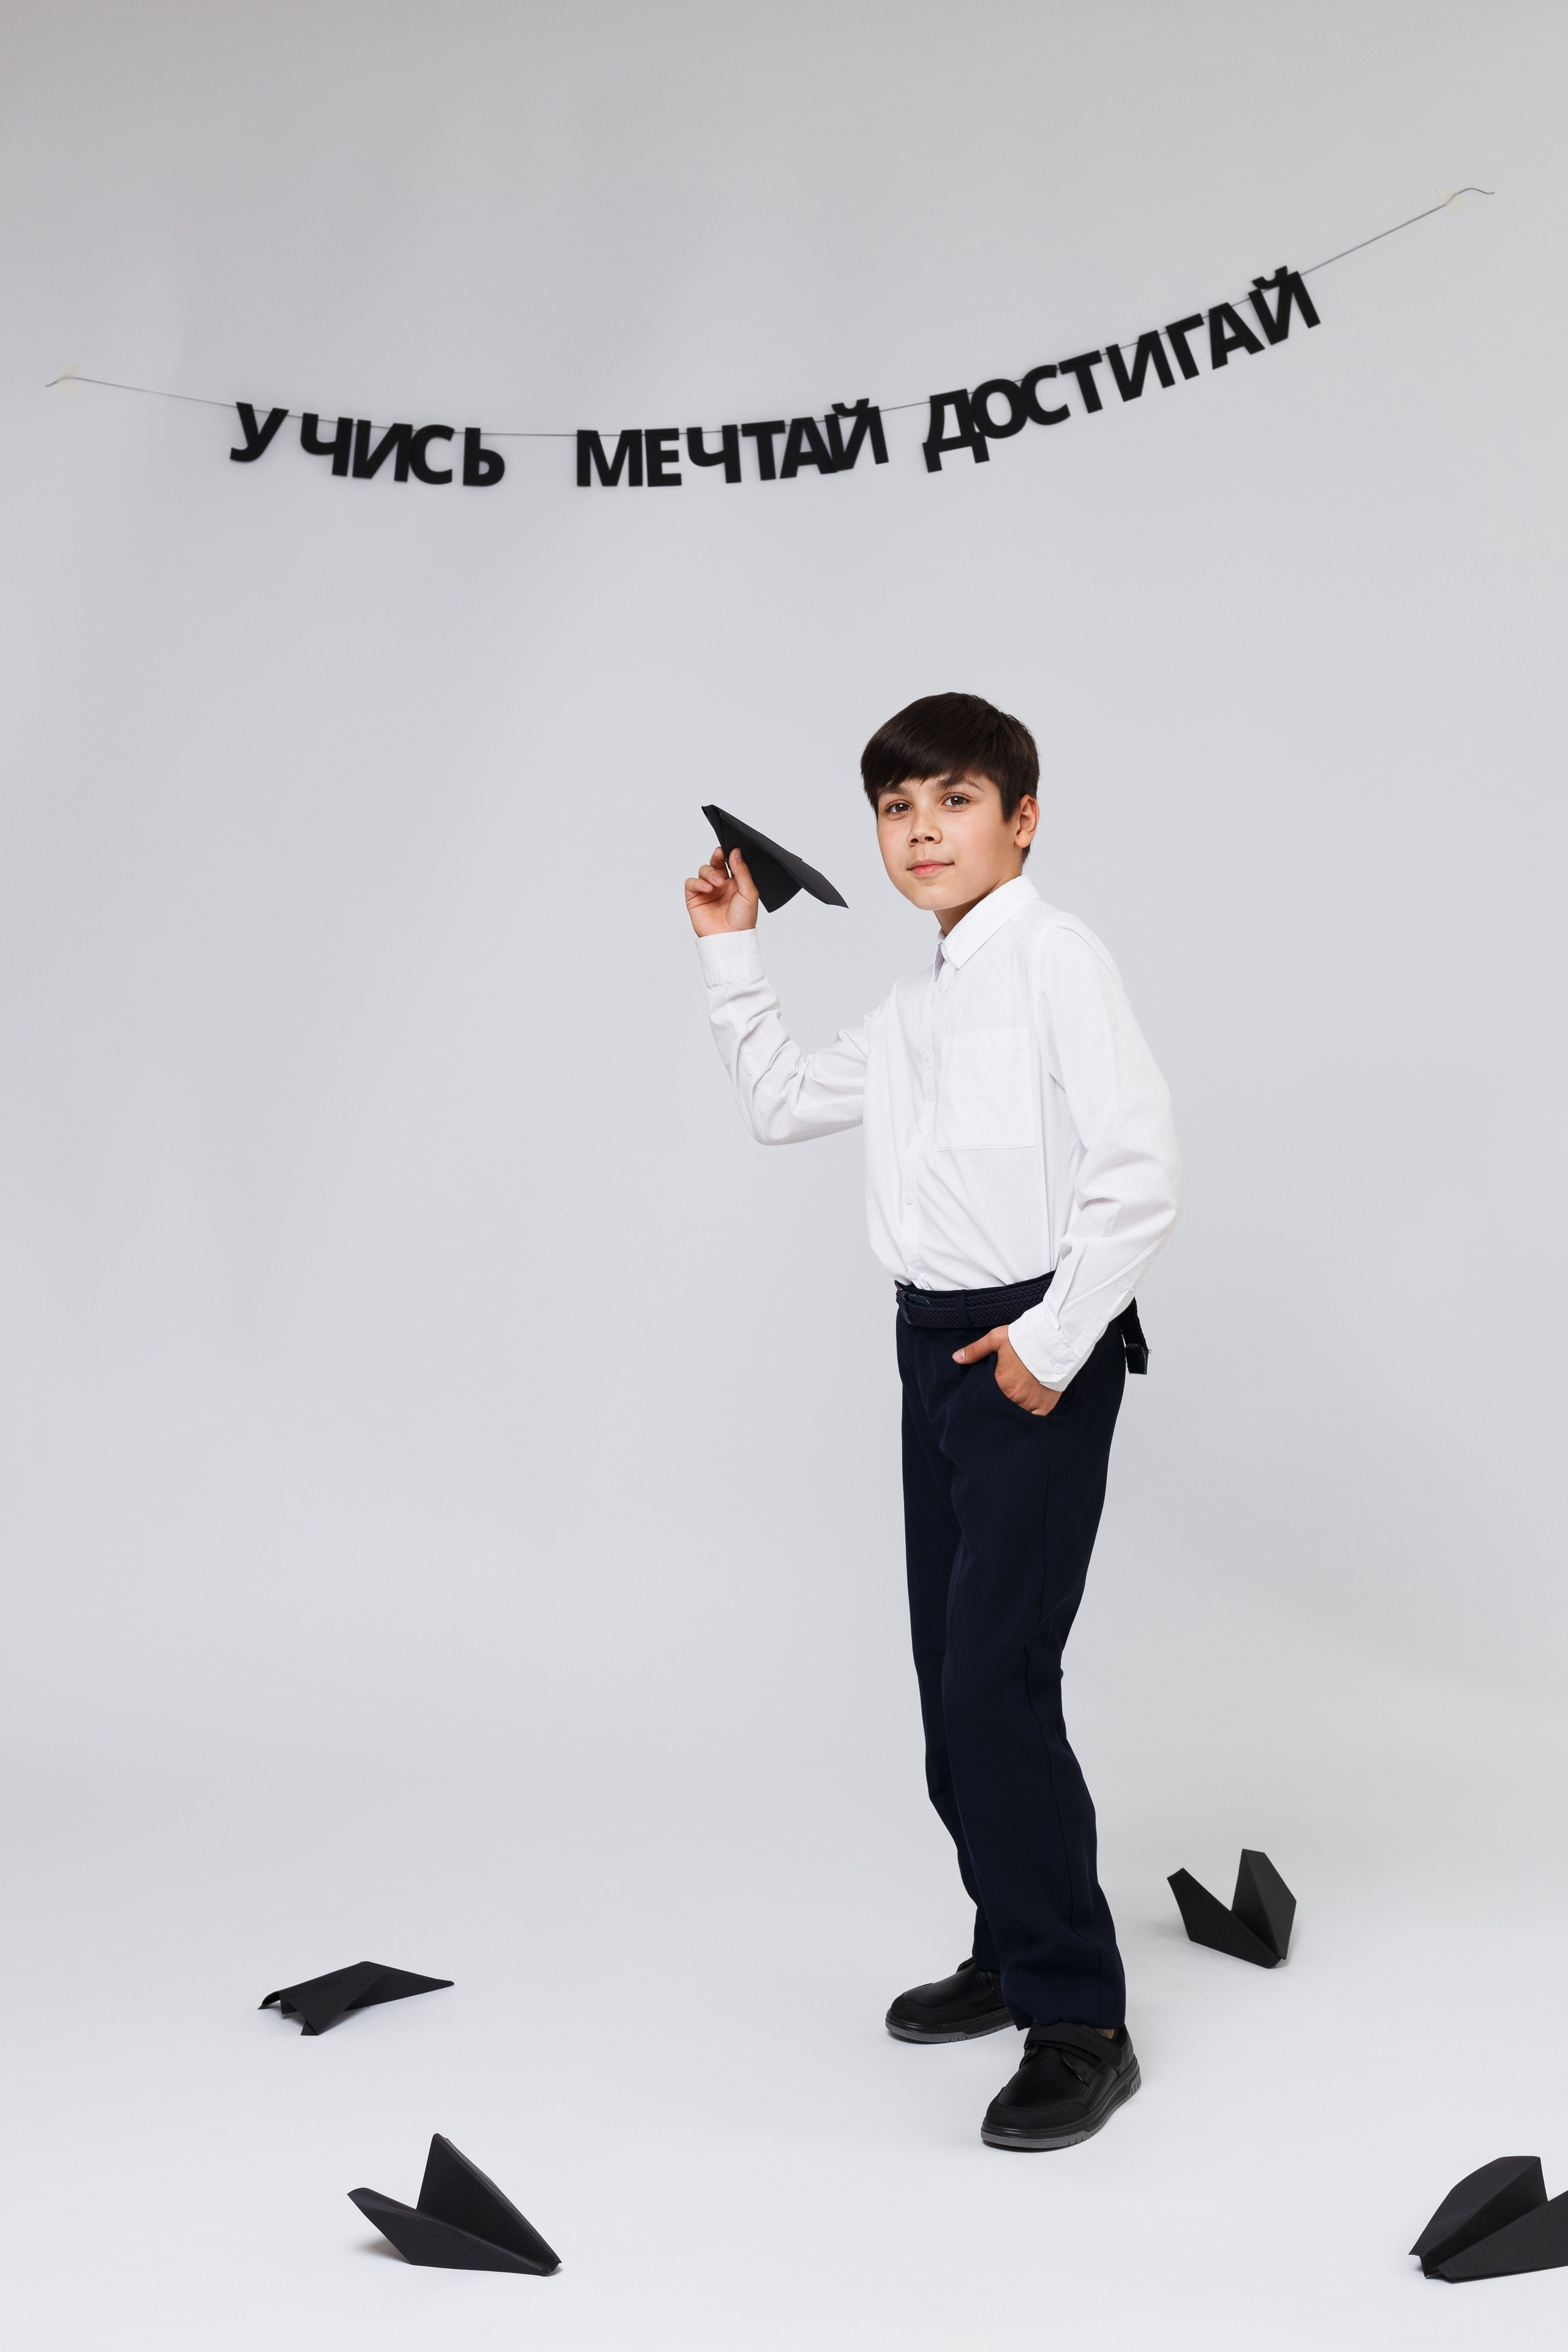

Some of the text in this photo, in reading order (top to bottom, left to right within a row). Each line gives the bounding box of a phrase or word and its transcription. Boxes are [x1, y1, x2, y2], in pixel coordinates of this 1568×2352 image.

[229, 265, 1321, 488] УЧИСЬ МЕЧТАЙ ДОСТИГАЙ
